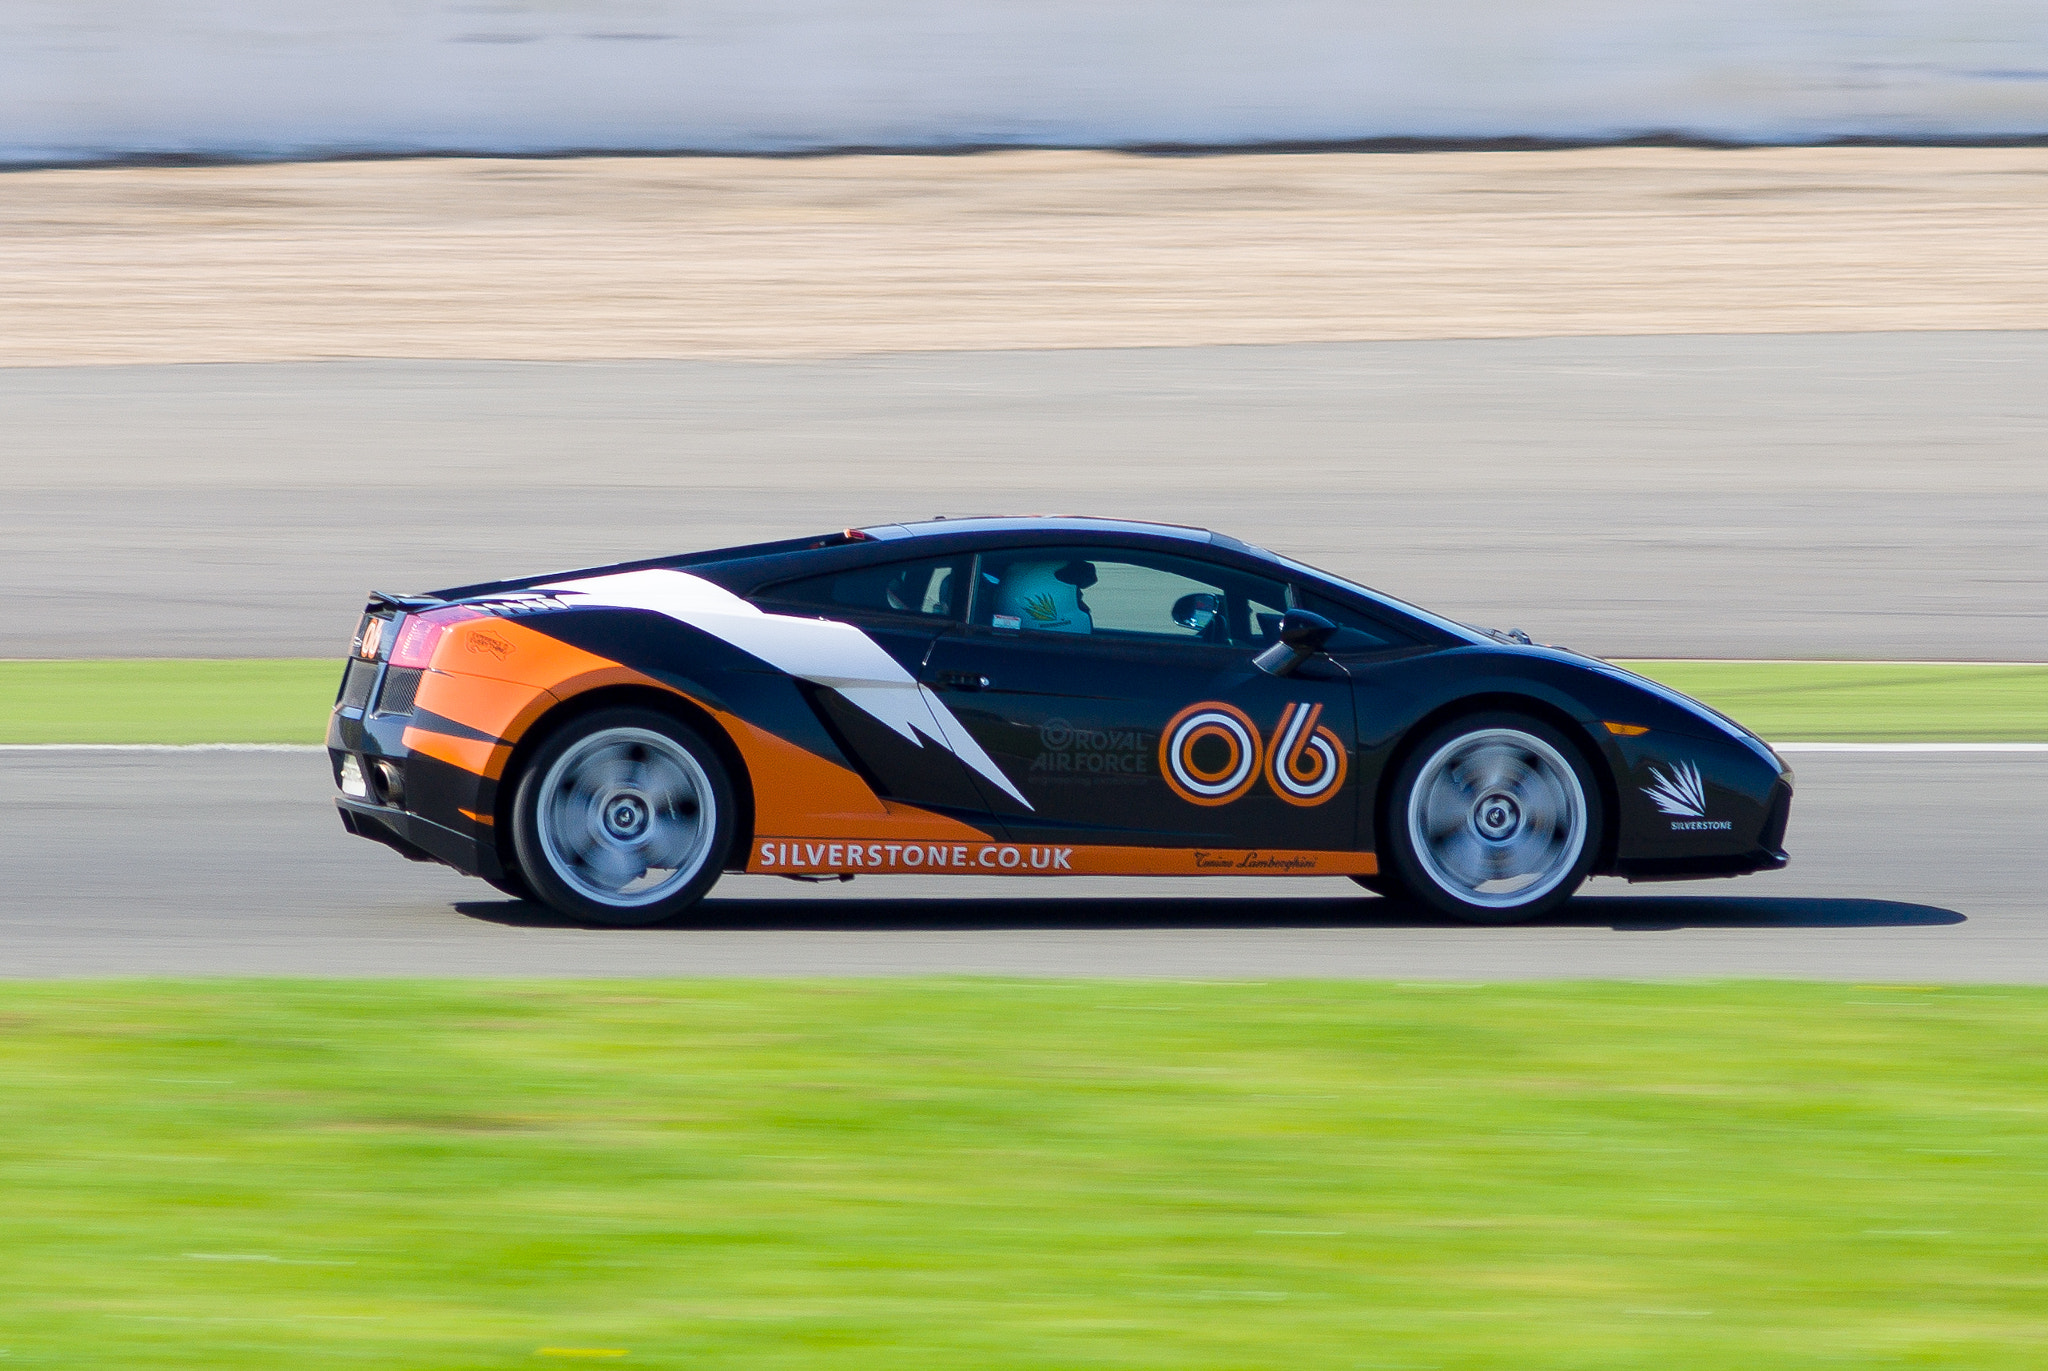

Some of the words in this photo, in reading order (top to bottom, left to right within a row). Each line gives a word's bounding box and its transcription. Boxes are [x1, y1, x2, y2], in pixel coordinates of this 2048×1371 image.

[1075, 730, 1148, 751] ROYAL
[1030, 752, 1071, 771] AIR
[1075, 752, 1148, 773] FORCE
[1158, 701, 1348, 807] 06
[1670, 821, 1732, 831] SILVERSTONE
[760, 843, 1072, 870] SILVERSTONE.CO.UK
